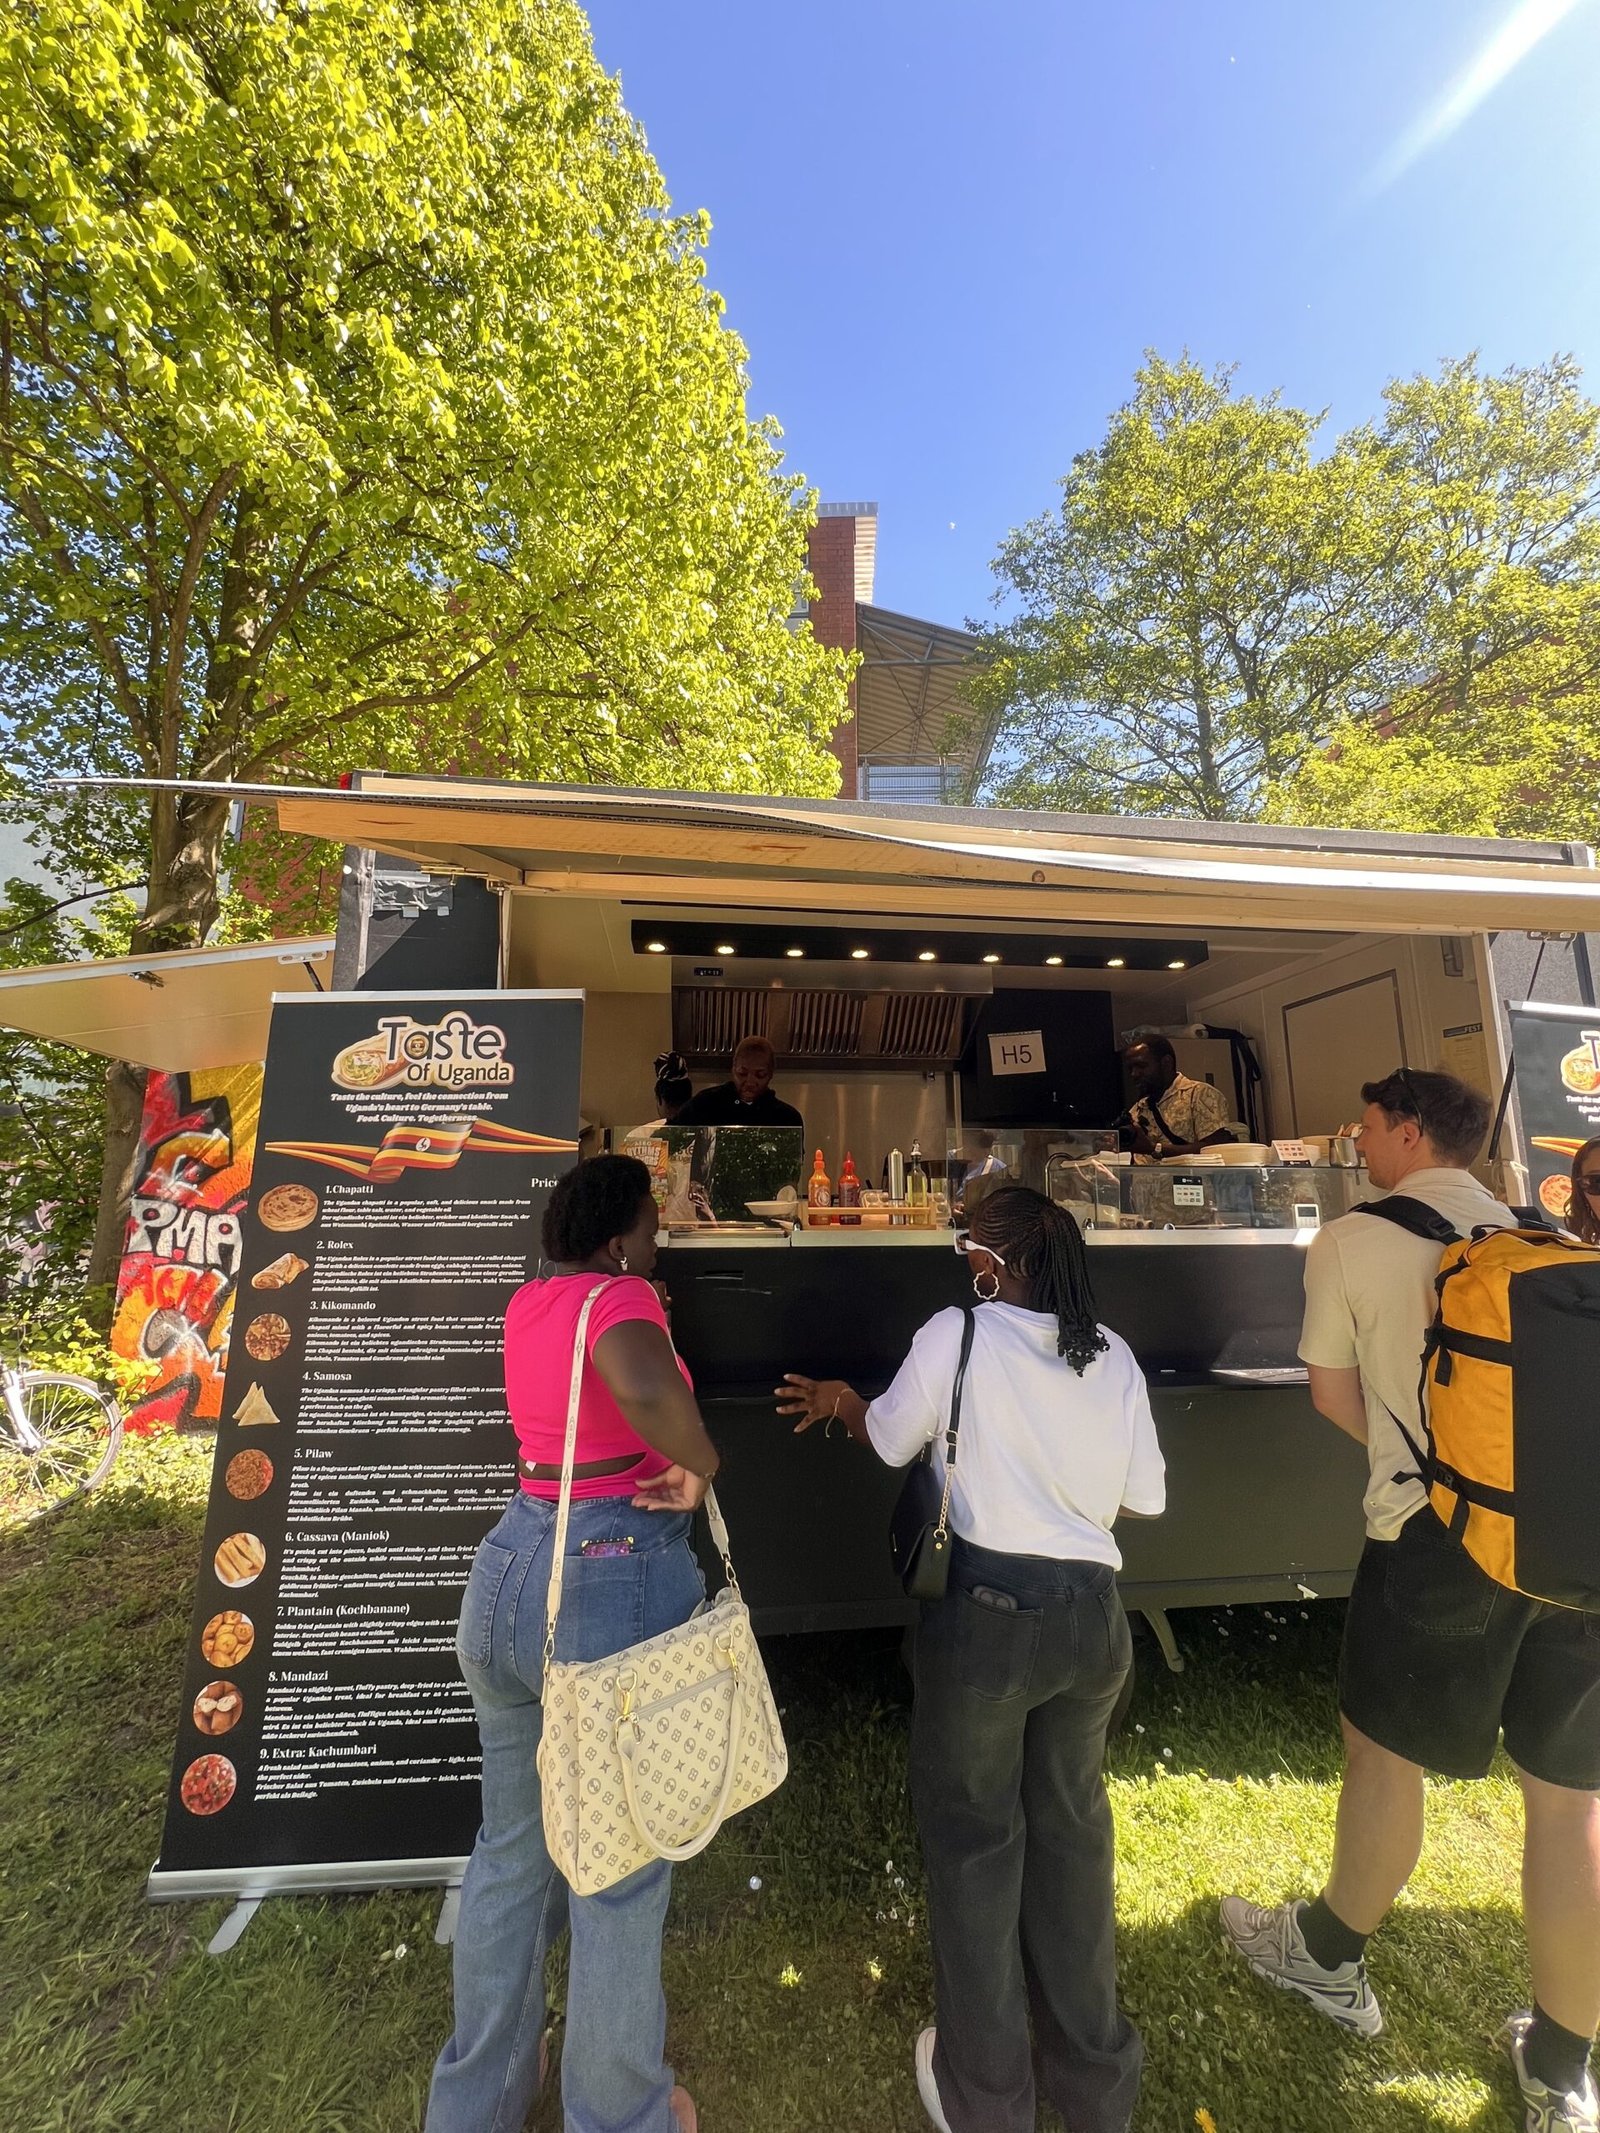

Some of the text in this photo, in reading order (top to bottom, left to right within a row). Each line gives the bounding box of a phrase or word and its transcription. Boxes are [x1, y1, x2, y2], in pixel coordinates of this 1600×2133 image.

[382, 1016, 502, 1062] Taste
[1002, 1043, 1033, 1065] H5
[407, 1061, 510, 1085] Of Uganda
[330, 1091, 508, 1101] Taste the culture, feel the connection from
[345, 1103, 384, 1113] Uganda's
[384, 1103, 409, 1111] heart
[420, 1102, 467, 1112] Germany's
[468, 1102, 492, 1110] table.
[380, 1114, 416, 1122] Culture.
[417, 1113, 478, 1123] Togetherness.
[128, 1198, 244, 1274] PMA
[316, 1241, 354, 1249] 2. Rolex
[310, 1300, 376, 1310] 3. Kikomando
[302, 1371, 352, 1381] 4. Samosa
[294, 1449, 333, 1459] 5. Pilaw
[285, 1530, 390, 1544] 6. Cassava (Maniok)
[277, 1603, 411, 1617] 7. Plantain (Kochbanane)
[268, 1670, 328, 1682] 8. Mandazi
[259, 1744, 377, 1759] 9. Extra: Kachumbari
